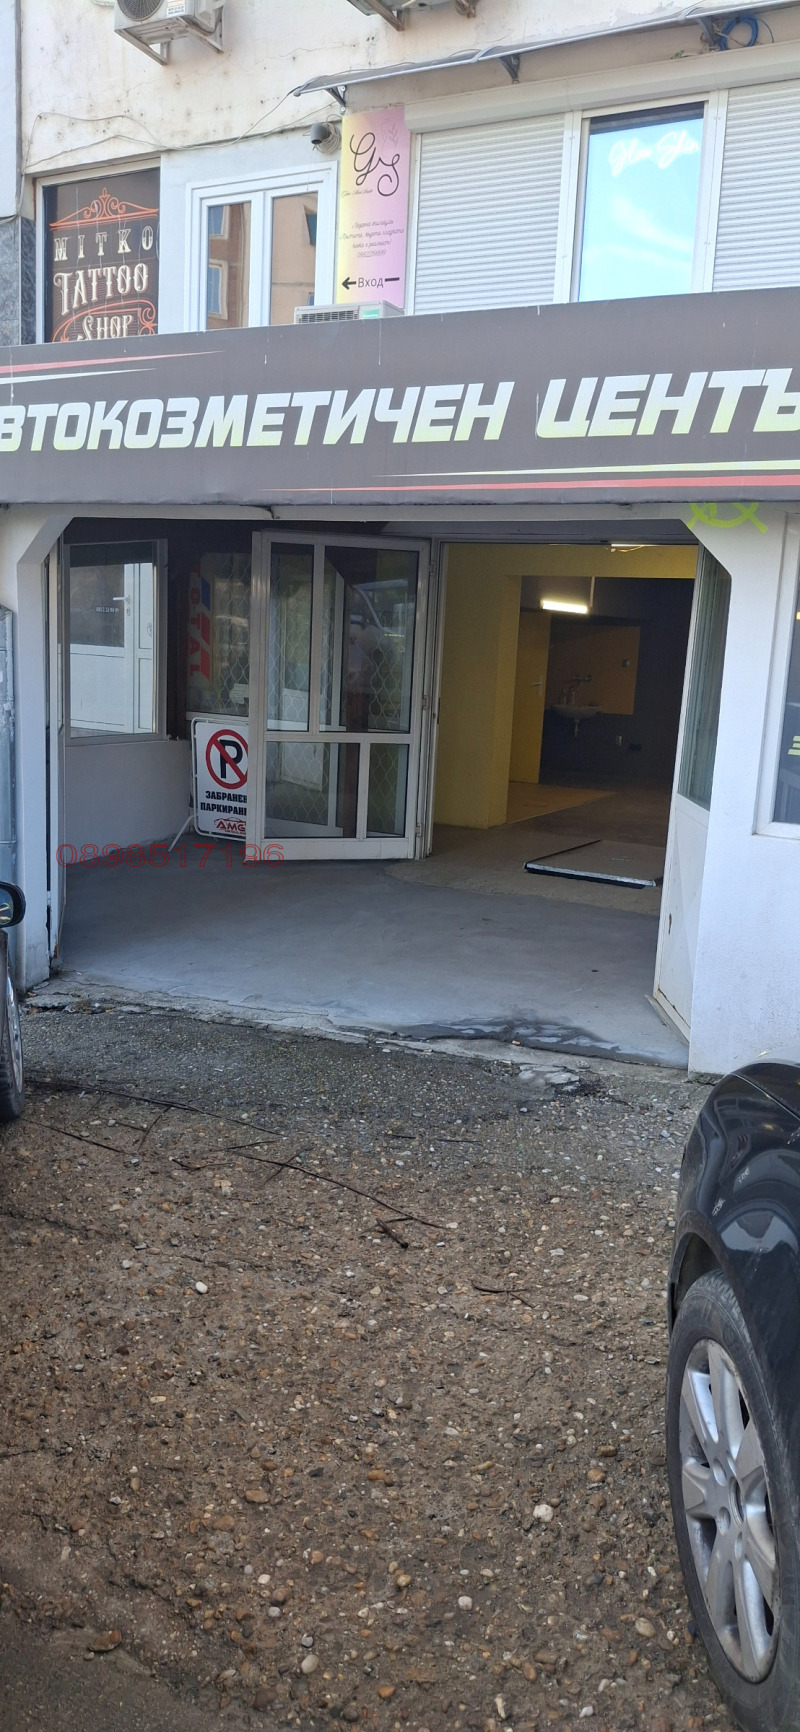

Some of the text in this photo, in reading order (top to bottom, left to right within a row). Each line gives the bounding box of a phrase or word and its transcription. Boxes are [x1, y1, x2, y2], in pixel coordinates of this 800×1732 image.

[54, 226, 154, 262] MITKO
[53, 262, 149, 316] TATTOO
[357, 276, 384, 289] Вход
